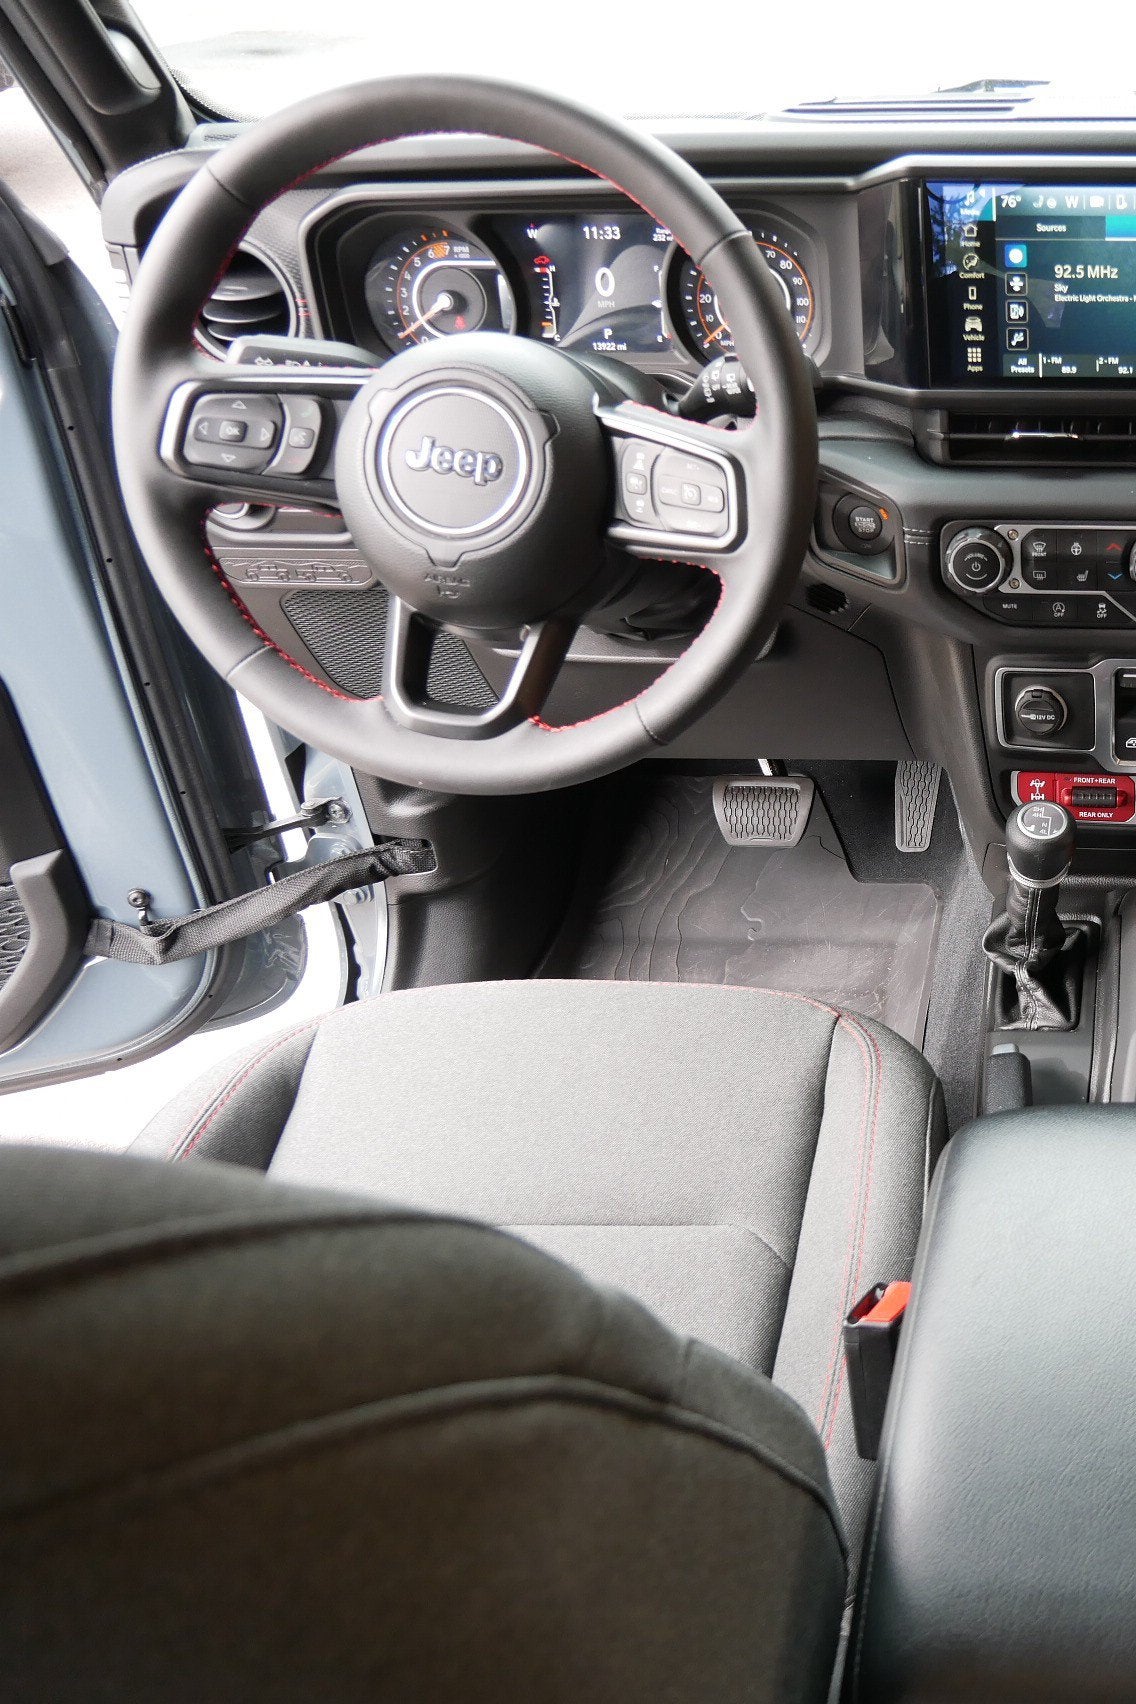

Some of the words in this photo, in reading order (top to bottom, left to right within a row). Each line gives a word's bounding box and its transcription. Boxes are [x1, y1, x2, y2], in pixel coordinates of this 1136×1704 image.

[1036, 222, 1067, 233] Sources
[583, 226, 621, 241] 11:33
[427, 249, 435, 258] 6
[766, 250, 776, 259] 70
[414, 258, 422, 267] 5
[779, 260, 793, 270] 80
[959, 271, 985, 280] Comfort
[1053, 264, 1085, 279] 92.5
[1087, 264, 1119, 279] MHz
[404, 272, 412, 281] 4
[595, 266, 616, 298] 0
[792, 277, 803, 286] 90
[400, 287, 408, 298] 3
[1053, 283, 1069, 294] Sky
[699, 294, 712, 304] 20
[796, 297, 810, 307] 100
[1054, 294, 1079, 303] Electric
[1080, 294, 1096, 304] Light
[1097, 294, 1129, 303] Orchestra
[402, 306, 410, 316] 2
[963, 302, 983, 311] Phone
[705, 315, 714, 323] 10
[796, 316, 807, 324] 110
[604, 328, 613, 339] P
[963, 333, 985, 342] Vehicle
[592, 343, 616, 351] 13922
[616, 343, 627, 351] mi
[1017, 357, 1027, 365] All
[967, 364, 983, 374] Apps
[1010, 365, 1035, 374] Presets
[405, 435, 504, 486] Jeep
[1073, 776, 1116, 784] FRONT+REAR
